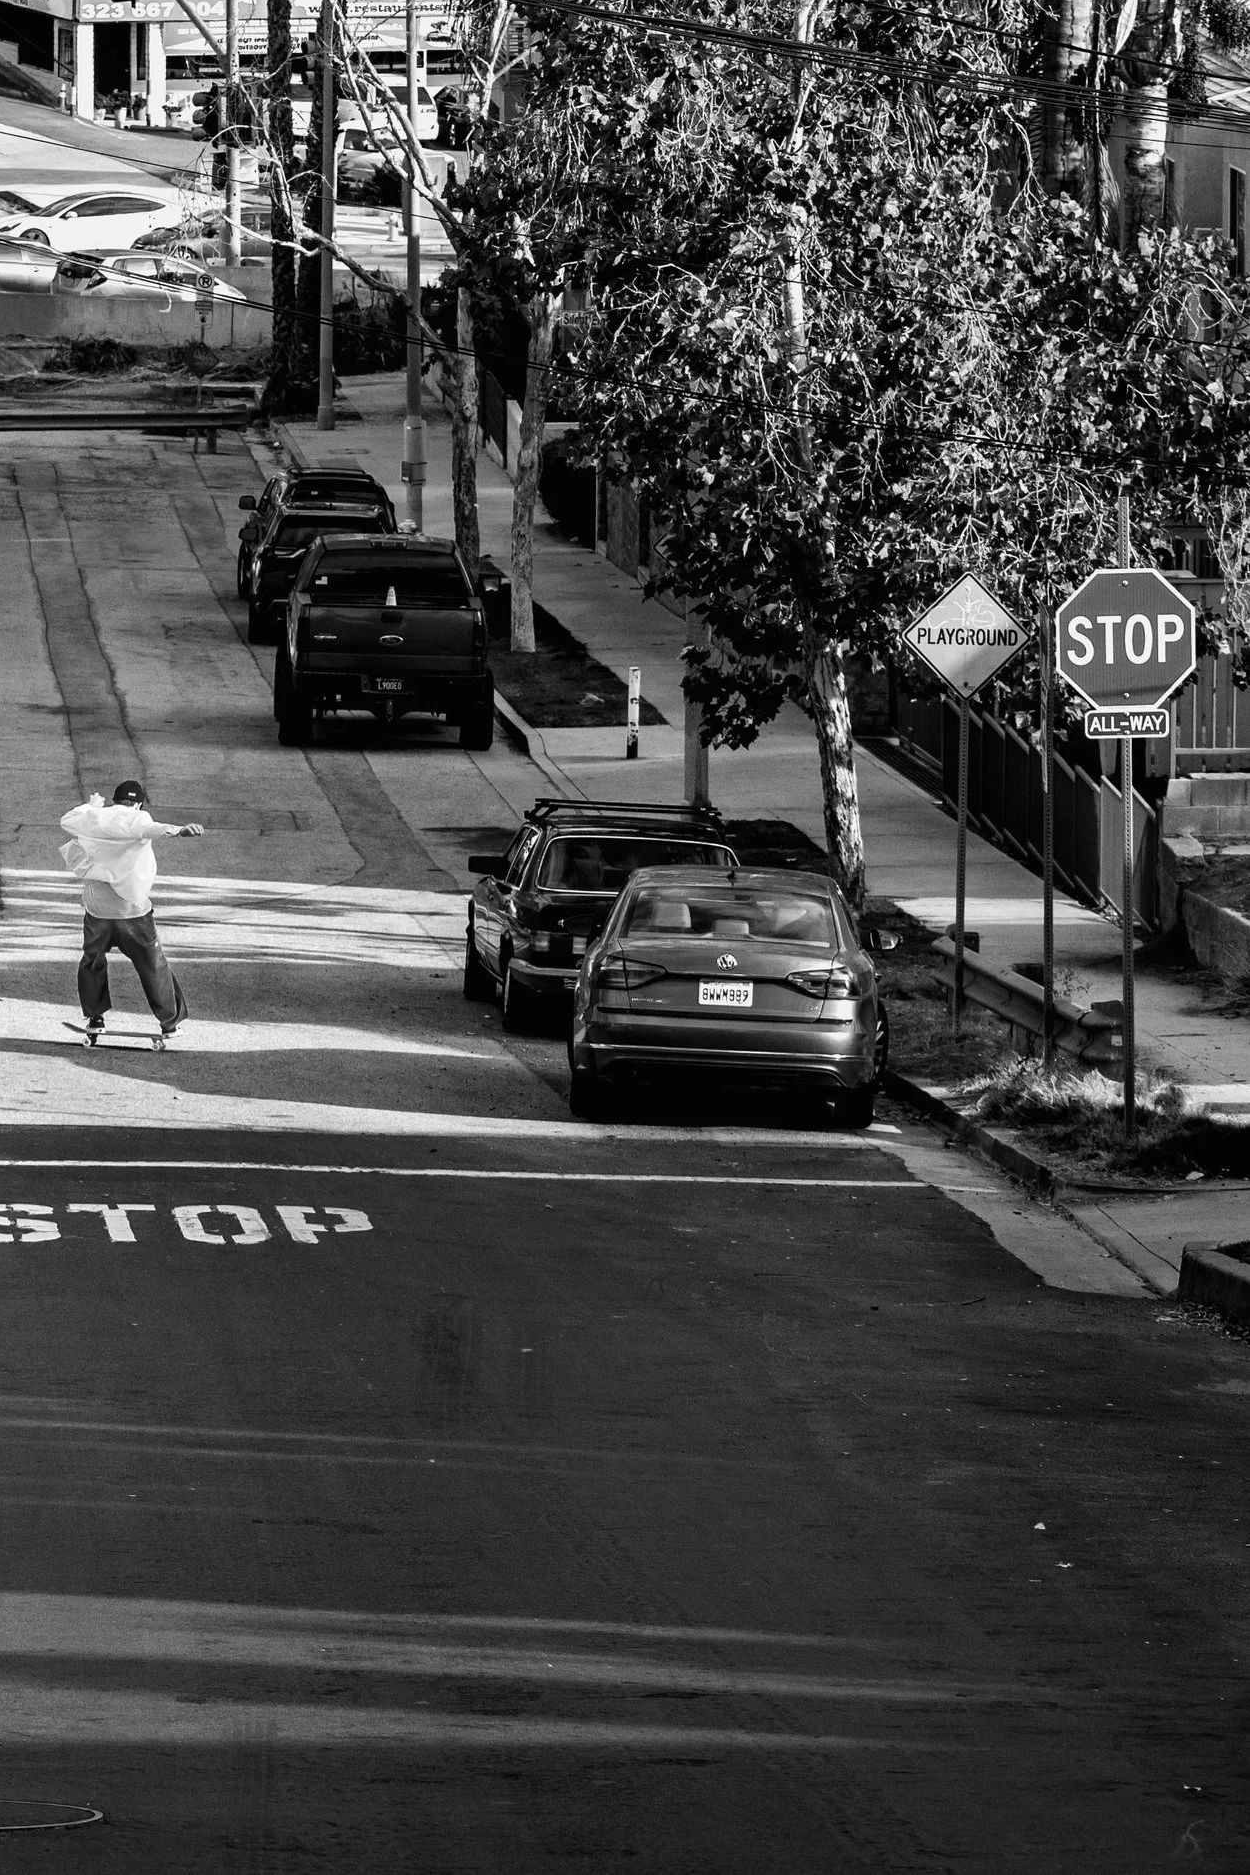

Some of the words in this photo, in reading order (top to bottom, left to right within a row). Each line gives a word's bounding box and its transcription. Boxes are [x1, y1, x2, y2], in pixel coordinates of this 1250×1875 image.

[81, 3, 125, 20] 323
[132, 1, 175, 18] 667
[917, 627, 1019, 647] PLAYGROUND
[1066, 613, 1185, 666] STOP
[1089, 714, 1164, 733] ALL-WAY
